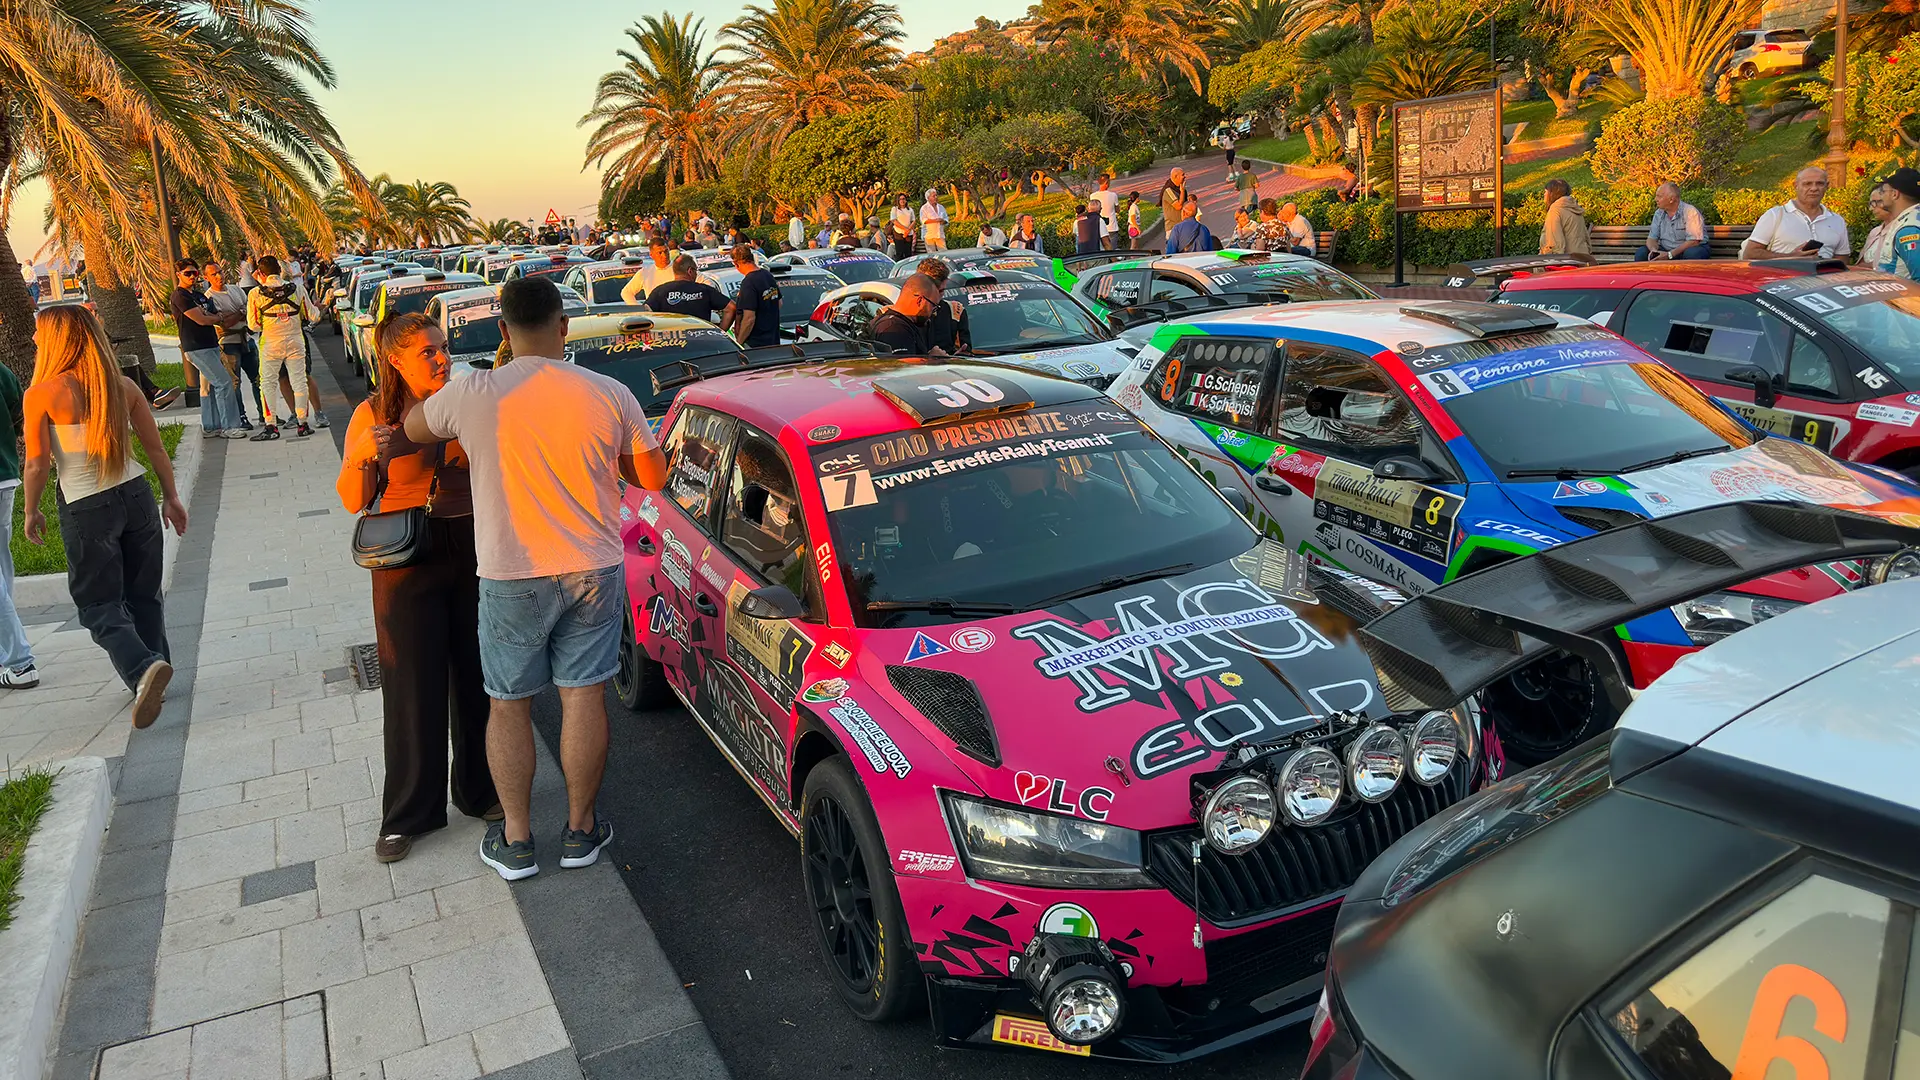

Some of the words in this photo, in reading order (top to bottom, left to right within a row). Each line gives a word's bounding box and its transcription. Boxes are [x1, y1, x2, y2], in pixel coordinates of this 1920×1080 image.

[667, 291, 681, 301] BR
[960, 282, 1024, 294] PRESIDENTE
[1097, 274, 1113, 299] 10
[1447, 277, 1465, 288] N5
[1832, 281, 1908, 299] Bertino
[450, 315, 468, 328] 16
[1755, 297, 1817, 338] www.tecnicabertino.it
[1160, 358, 1182, 401] 8
[1203, 374, 1261, 398] G.Schepisi
[1428, 372, 1461, 396] 8
[1458, 358, 1551, 385] Ferrara
[1856, 366, 1889, 390] N5
[917, 378, 1005, 409] 30
[1198, 392, 1256, 416] K.Schepisi
[870, 433, 929, 467] CIAO
[932, 411, 1070, 454] PRESIDENTE
[1803, 420, 1819, 444] 9
[874, 432, 1114, 490] www.ErreffeRallyTeam.it
[834, 473, 858, 507] 7
[1327, 473, 1367, 499] TINDARI
[1365, 483, 1403, 508] RALLY
[1425, 496, 1446, 526] 8
[700, 561, 728, 592] GIOVANNI
[815, 541, 832, 584] Elia
[1345, 538, 1407, 589] COSMAK
[824, 641, 852, 667] JEM
[1045, 633, 1149, 672] MARKETING
[1146, 630, 1163, 642] E
[1164, 606, 1292, 639] COMUNICAZIONE
[786, 637, 803, 675] 7
[705, 668, 788, 783] MAGISTR
[850, 705, 885, 741] QUAGLIE
[882, 743, 914, 778] UOVA
[711, 708, 802, 822] www.magistroauto.co
[1049, 779, 1115, 820] LC
[1731, 963, 1849, 1080] 6
